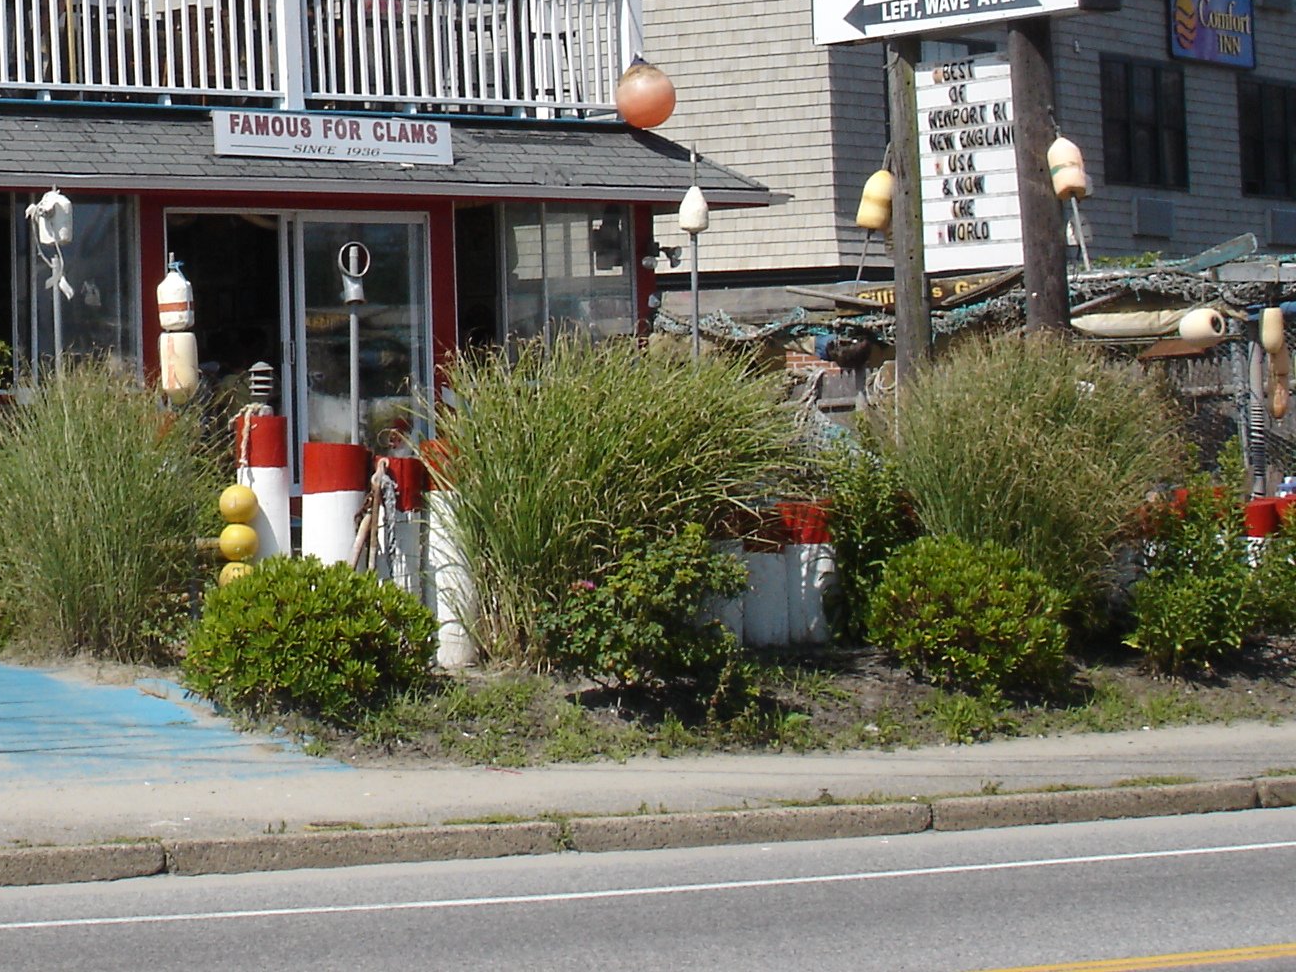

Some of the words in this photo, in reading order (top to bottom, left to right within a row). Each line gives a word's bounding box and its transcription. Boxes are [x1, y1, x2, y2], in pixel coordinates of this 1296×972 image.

[881, 0, 923, 22] LEFT,
[1219, 34, 1241, 54] INN
[942, 61, 975, 81] BEST
[948, 84, 966, 104] OF
[993, 102, 1008, 123] RI
[229, 113, 312, 139] FAMOUS
[322, 118, 362, 141] FOR
[373, 121, 438, 145] CLAMS
[929, 132, 955, 153] NEW
[959, 125, 1016, 149] ENGLAN
[292, 144, 337, 156] SINCE
[346, 146, 381, 158] 1936
[948, 153, 976, 173] USA
[942, 179, 953, 196] &
[955, 175, 985, 195] NOW
[951, 198, 975, 218] THE
[947, 221, 990, 243] WORLD
